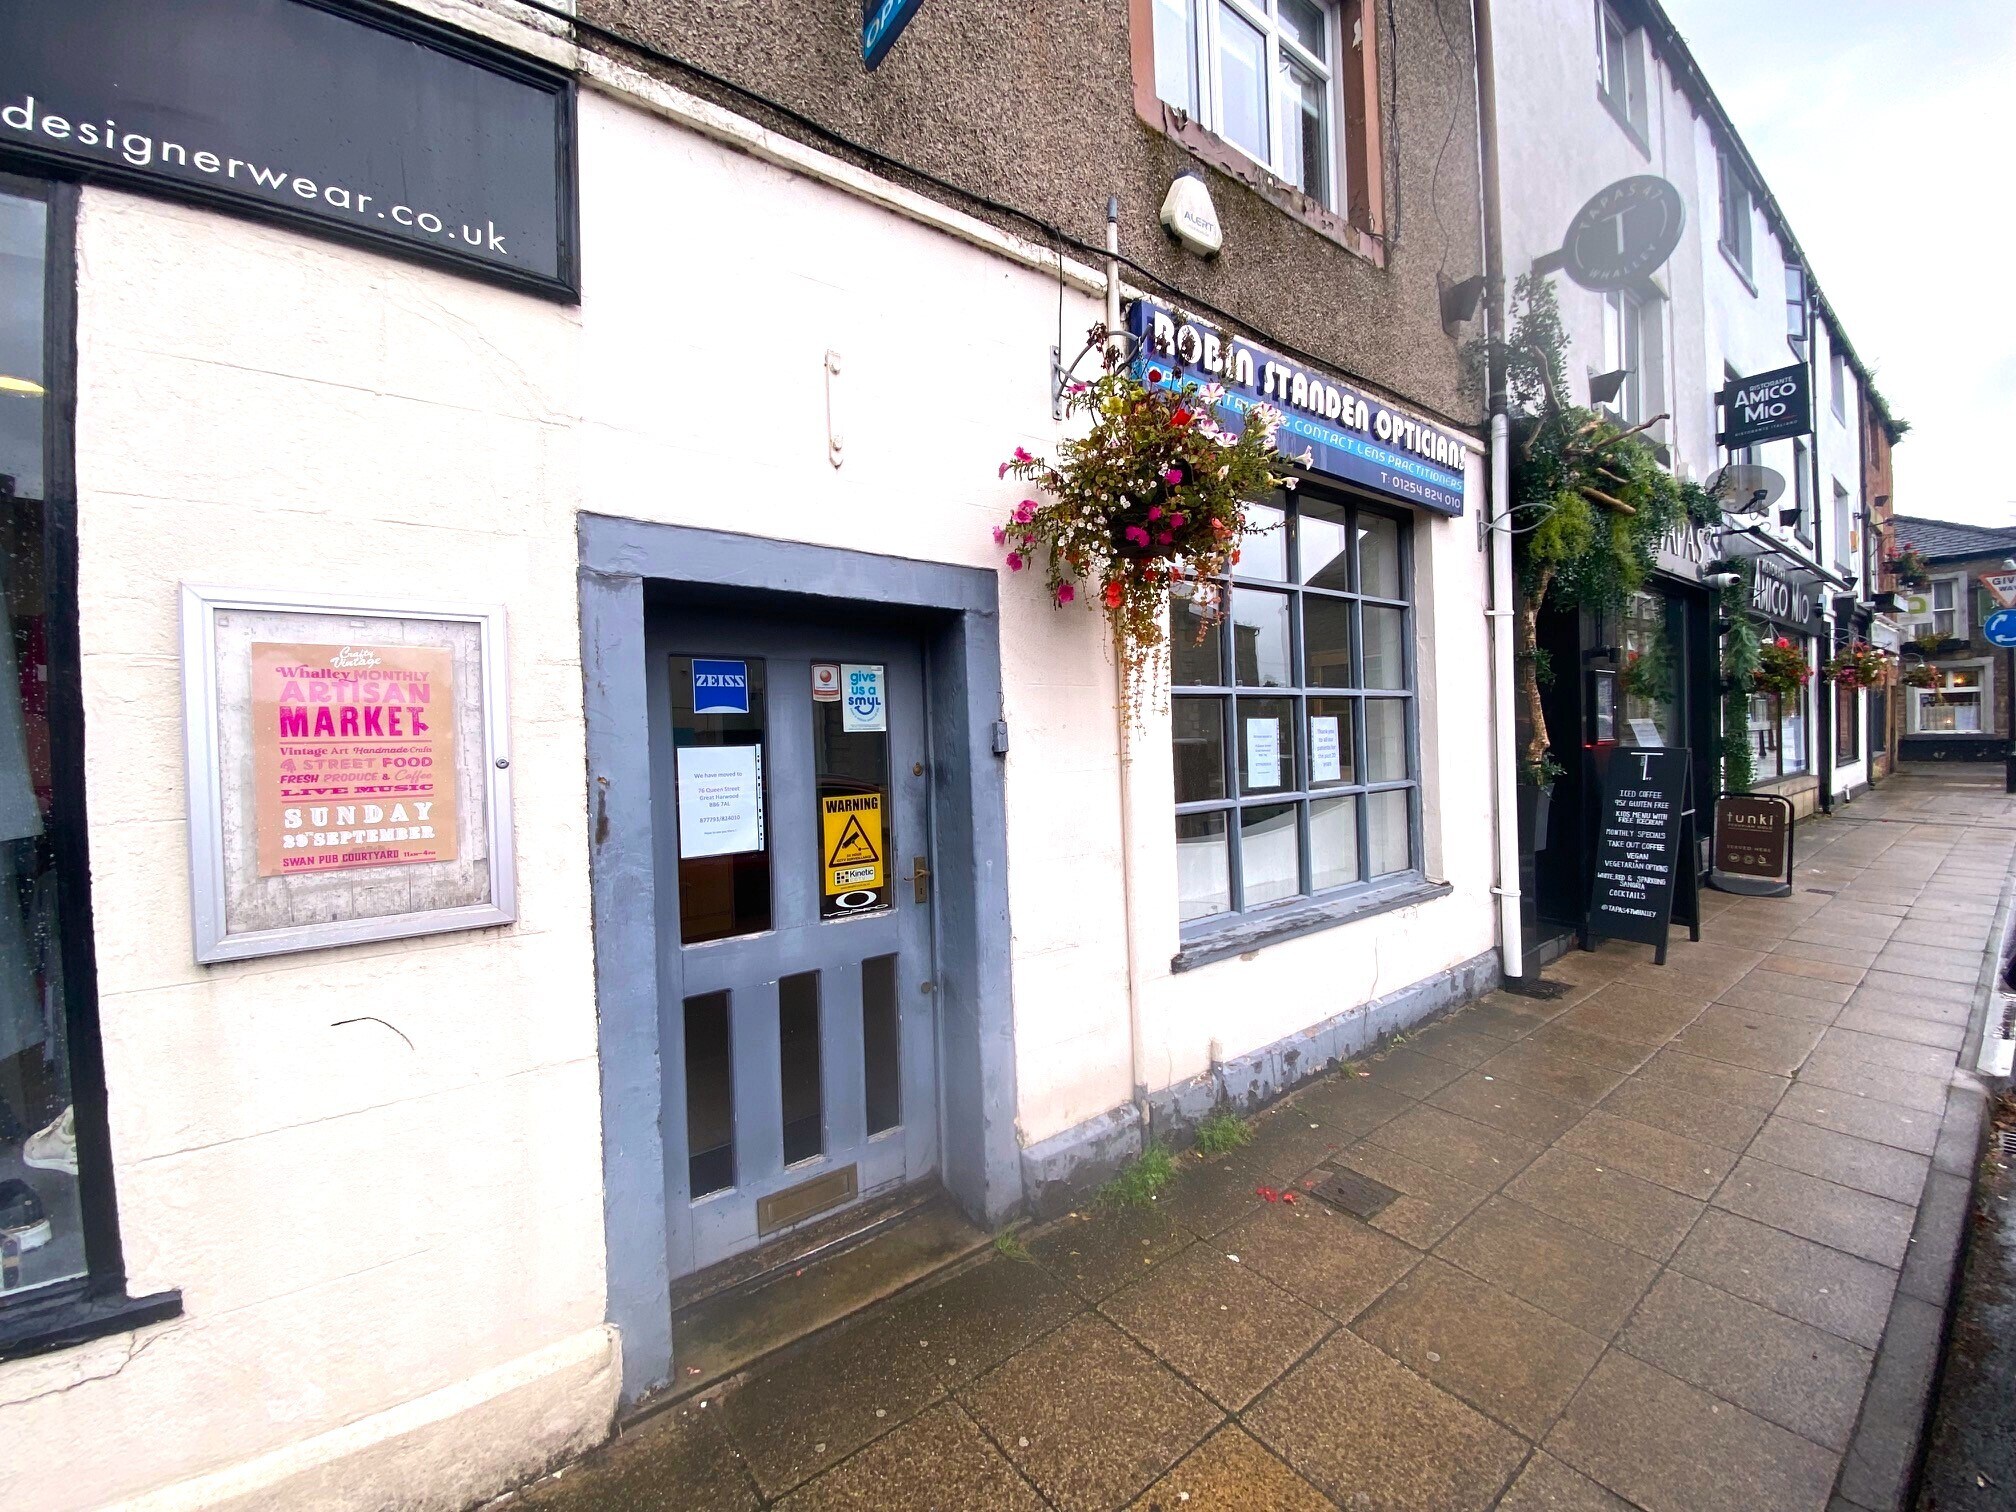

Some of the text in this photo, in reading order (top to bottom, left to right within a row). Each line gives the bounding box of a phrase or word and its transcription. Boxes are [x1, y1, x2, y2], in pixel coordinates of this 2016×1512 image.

[2, 96, 508, 256] designerwear.co.uk
[1184, 211, 1215, 232] ALERT
[1589, 243, 1656, 279] WHALLEY
[1734, 382, 1797, 409] AMICO
[1264, 361, 1369, 432] STANDEN
[1376, 410, 1467, 471] OPTICIANS
[1744, 402, 1786, 423] MIO
[1294, 420, 1354, 450] CONTACT
[1357, 443, 1386, 462] LENS
[1388, 454, 1462, 490] PRACTITIONERS
[1381, 472, 1461, 508] T: 01254 824 010
[1753, 558, 1809, 624] AMICO MIO
[329, 656, 382, 669] Vintage
[275, 664, 430, 683] Whalley MONTHLY
[850, 671, 876, 685] give
[695, 674, 745, 688] ZEISS
[279, 680, 431, 703] ARTISAN
[851, 686, 876, 695] us a
[279, 705, 430, 738] MARKET
[280, 747, 328, 757] Vintage
[330, 747, 349, 755] Art
[353, 746, 409, 754] Handmade
[303, 757, 433, 770] STREET FOOD
[280, 774, 320, 784] FRESH
[323, 772, 378, 783] PRODUCE
[394, 769, 433, 783] Coffee
[280, 783, 434, 797] LIVE MUSIC
[1620, 789, 1662, 799] ICED COFFEE
[826, 797, 879, 813] WARNING
[1628, 800, 1653, 808] GLUTEN
[1653, 801, 1670, 809] FREE
[284, 801, 433, 829] SUNDAY
[1615, 810, 1631, 818] KIDS
[1727, 811, 1773, 825] tunki
[1636, 818, 1663, 826] ICECREAM
[313, 825, 436, 847] SEPTEMBER
[1605, 828, 1666, 839] MONTHLY SPECIALS
[1625, 841, 1641, 849] OUT
[1641, 842, 1665, 851] COFFEE
[283, 857, 315, 867] SWAN
[318, 855, 339, 865] PUB
[342, 850, 399, 863] COURTYARD
[1626, 852, 1649, 860] VEGAN
[850, 869, 873, 877] Kinetic
[1604, 860, 1668, 873] VEGETARIAN OPTIONS
[1609, 889, 1646, 899] COCKTAILS
